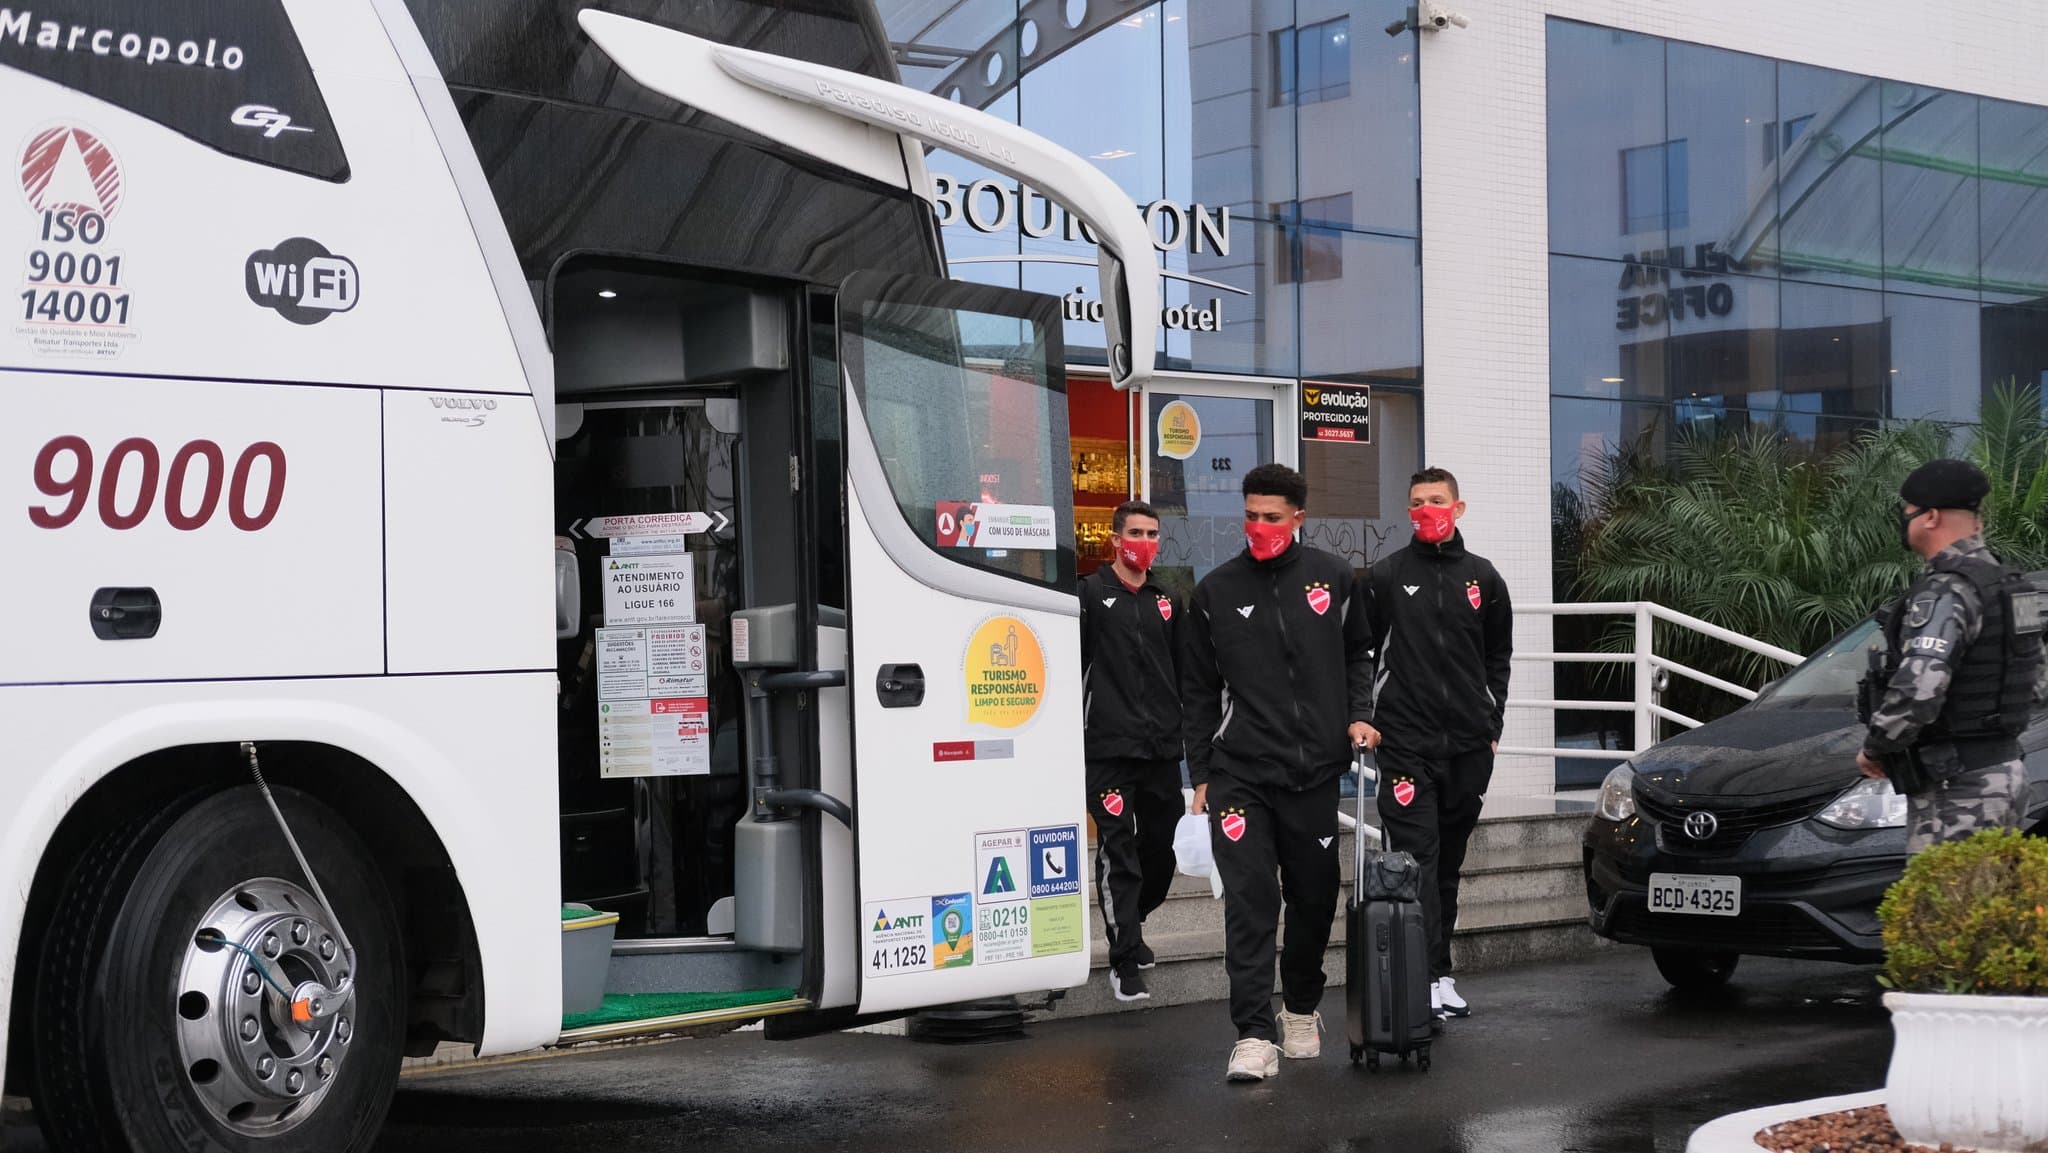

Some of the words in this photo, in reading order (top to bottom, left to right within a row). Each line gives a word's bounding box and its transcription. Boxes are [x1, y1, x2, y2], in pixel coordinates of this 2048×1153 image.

[0, 8, 244, 70] Marcopolo
[930, 172, 1230, 257] BOUON
[41, 209, 106, 244] ISO
[28, 250, 121, 286] 9001
[20, 288, 130, 325] 14001
[1158, 297, 1222, 332] otel
[428, 396, 498, 411] VOLVO
[1320, 390, 1368, 409] evolução
[1303, 411, 1351, 423] PROTEGIDO
[1352, 414, 1368, 425] 24H
[28, 434, 287, 531] 9000
[604, 517, 636, 526] PORTA
[988, 527, 1001, 536] COM
[1003, 527, 1014, 536] USO
[1015, 527, 1022, 536] DE
[1023, 526, 1050, 537] MÁSCARA
[612, 571, 685, 583] ATENDIMENTO
[617, 585, 632, 594] AO
[624, 600, 655, 610] LIGUE
[658, 599, 675, 608] 166
[983, 670, 1027, 681] TURISMO
[971, 681, 1039, 695] RESPONSÁVEL
[975, 698, 999, 707] LIMPO
[1000, 698, 1005, 706] E
[1006, 697, 1036, 706] SEGURO
[982, 837, 1013, 847] AGEPAR
[1033, 831, 1075, 845] OUVIDORIA
[1031, 884, 1050, 894] 0800
[1051, 881, 1078, 892] 6442013
[893, 915, 924, 930] ANTT
[992, 905, 1028, 928] 0219
[979, 929, 1008, 942] 0800-41
[1010, 927, 1028, 938] 0158
[872, 944, 927, 970] 41.1252
